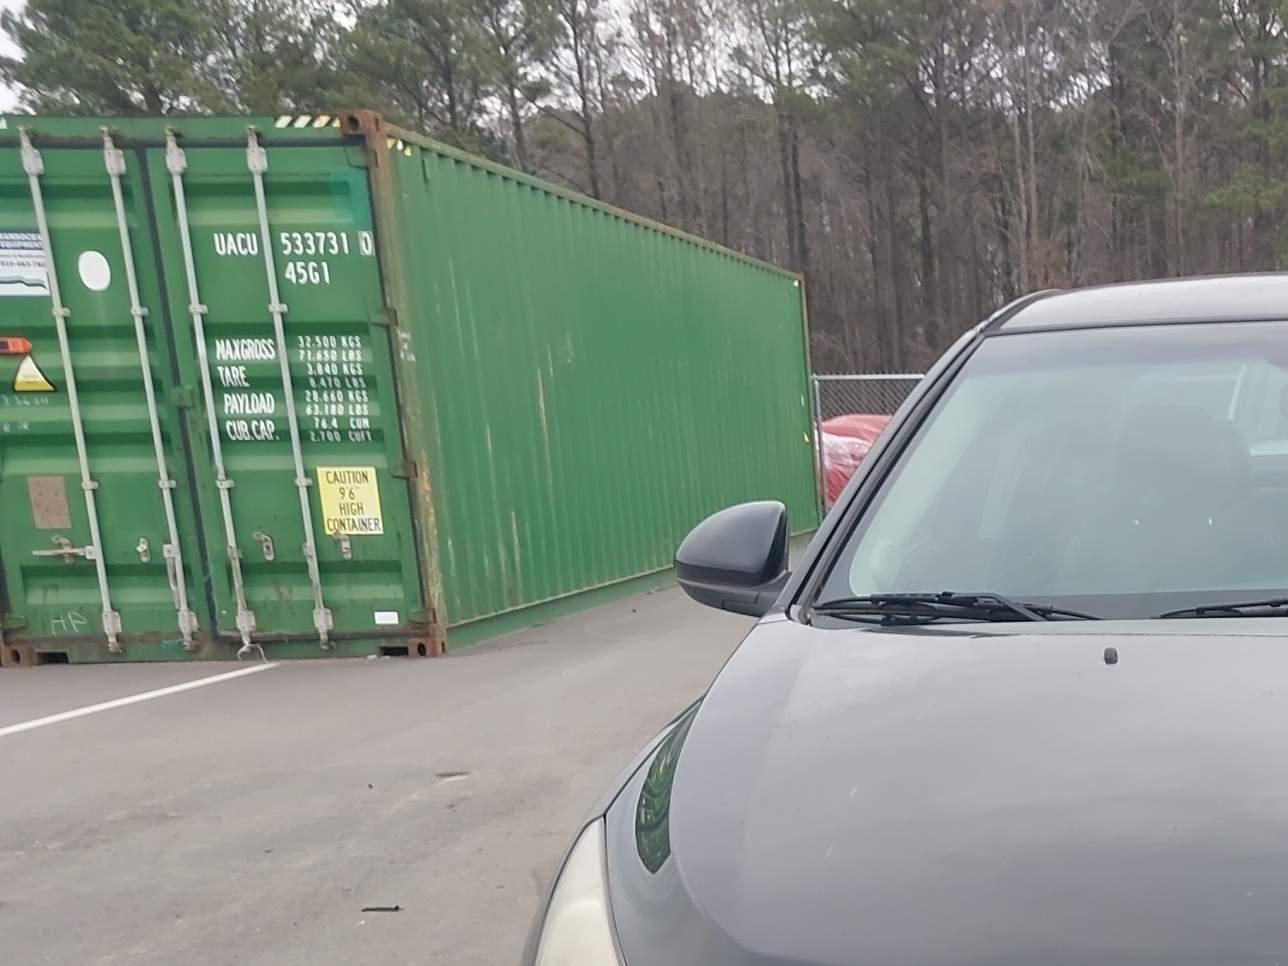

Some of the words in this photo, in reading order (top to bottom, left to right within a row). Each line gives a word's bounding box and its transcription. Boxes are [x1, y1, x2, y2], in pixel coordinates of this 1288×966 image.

[213, 232, 259, 256] UACU
[280, 231, 350, 256] 533731
[284, 261, 331, 285] 45G1
[340, 335, 362, 349] KGS
[342, 362, 364, 376] KGS
[216, 365, 251, 388] TARE
[347, 389, 370, 403] KGS
[223, 392, 276, 415] PAYLOAD
[325, 470, 369, 484] CAUTION
[339, 502, 365, 516] HIGH
[326, 517, 381, 532] CONTAINER
